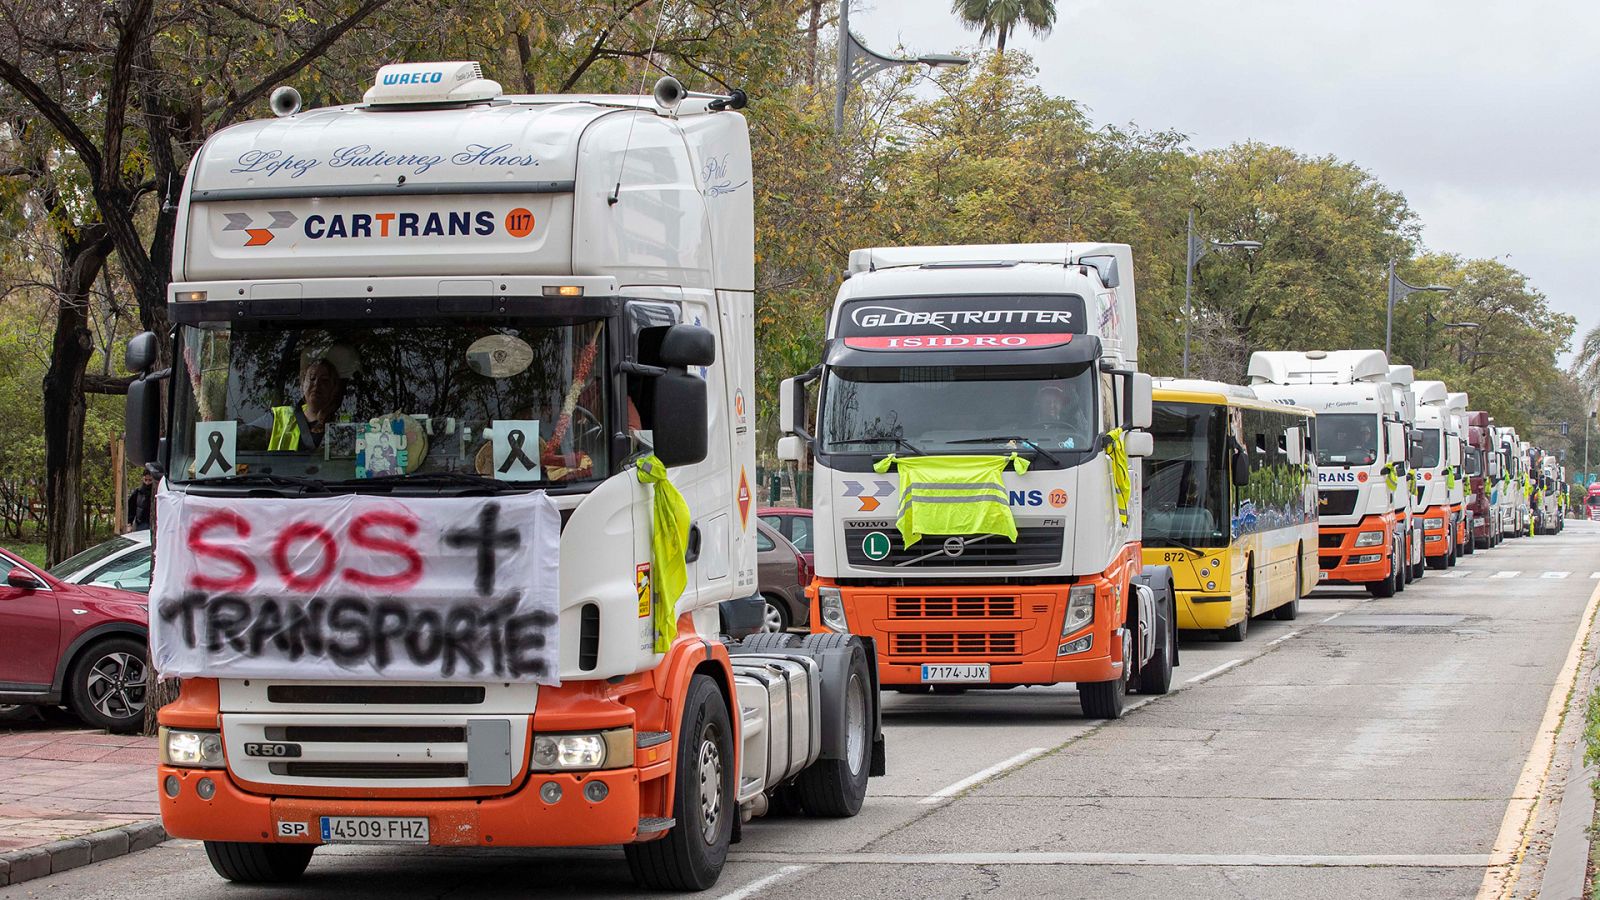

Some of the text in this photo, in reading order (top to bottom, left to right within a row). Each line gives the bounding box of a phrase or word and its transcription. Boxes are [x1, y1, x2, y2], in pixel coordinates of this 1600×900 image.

[383, 71, 442, 85] WAECO
[230, 143, 540, 179] Lopez Gutierrez Hnos.
[304, 211, 531, 239] CARTRANS 117
[858, 309, 1072, 329] GLOBETROTTER
[888, 336, 1027, 348] ISIDRO
[1050, 493, 1067, 504] 125
[187, 508, 424, 593] SOS
[870, 537, 882, 554] L
[1164, 552, 1184, 562] 872
[158, 590, 558, 679] TRANSPORTE
[931, 667, 985, 678] 7174 JJX
[281, 823, 305, 835] SP
[334, 820, 424, 839] 4509 FHZ
